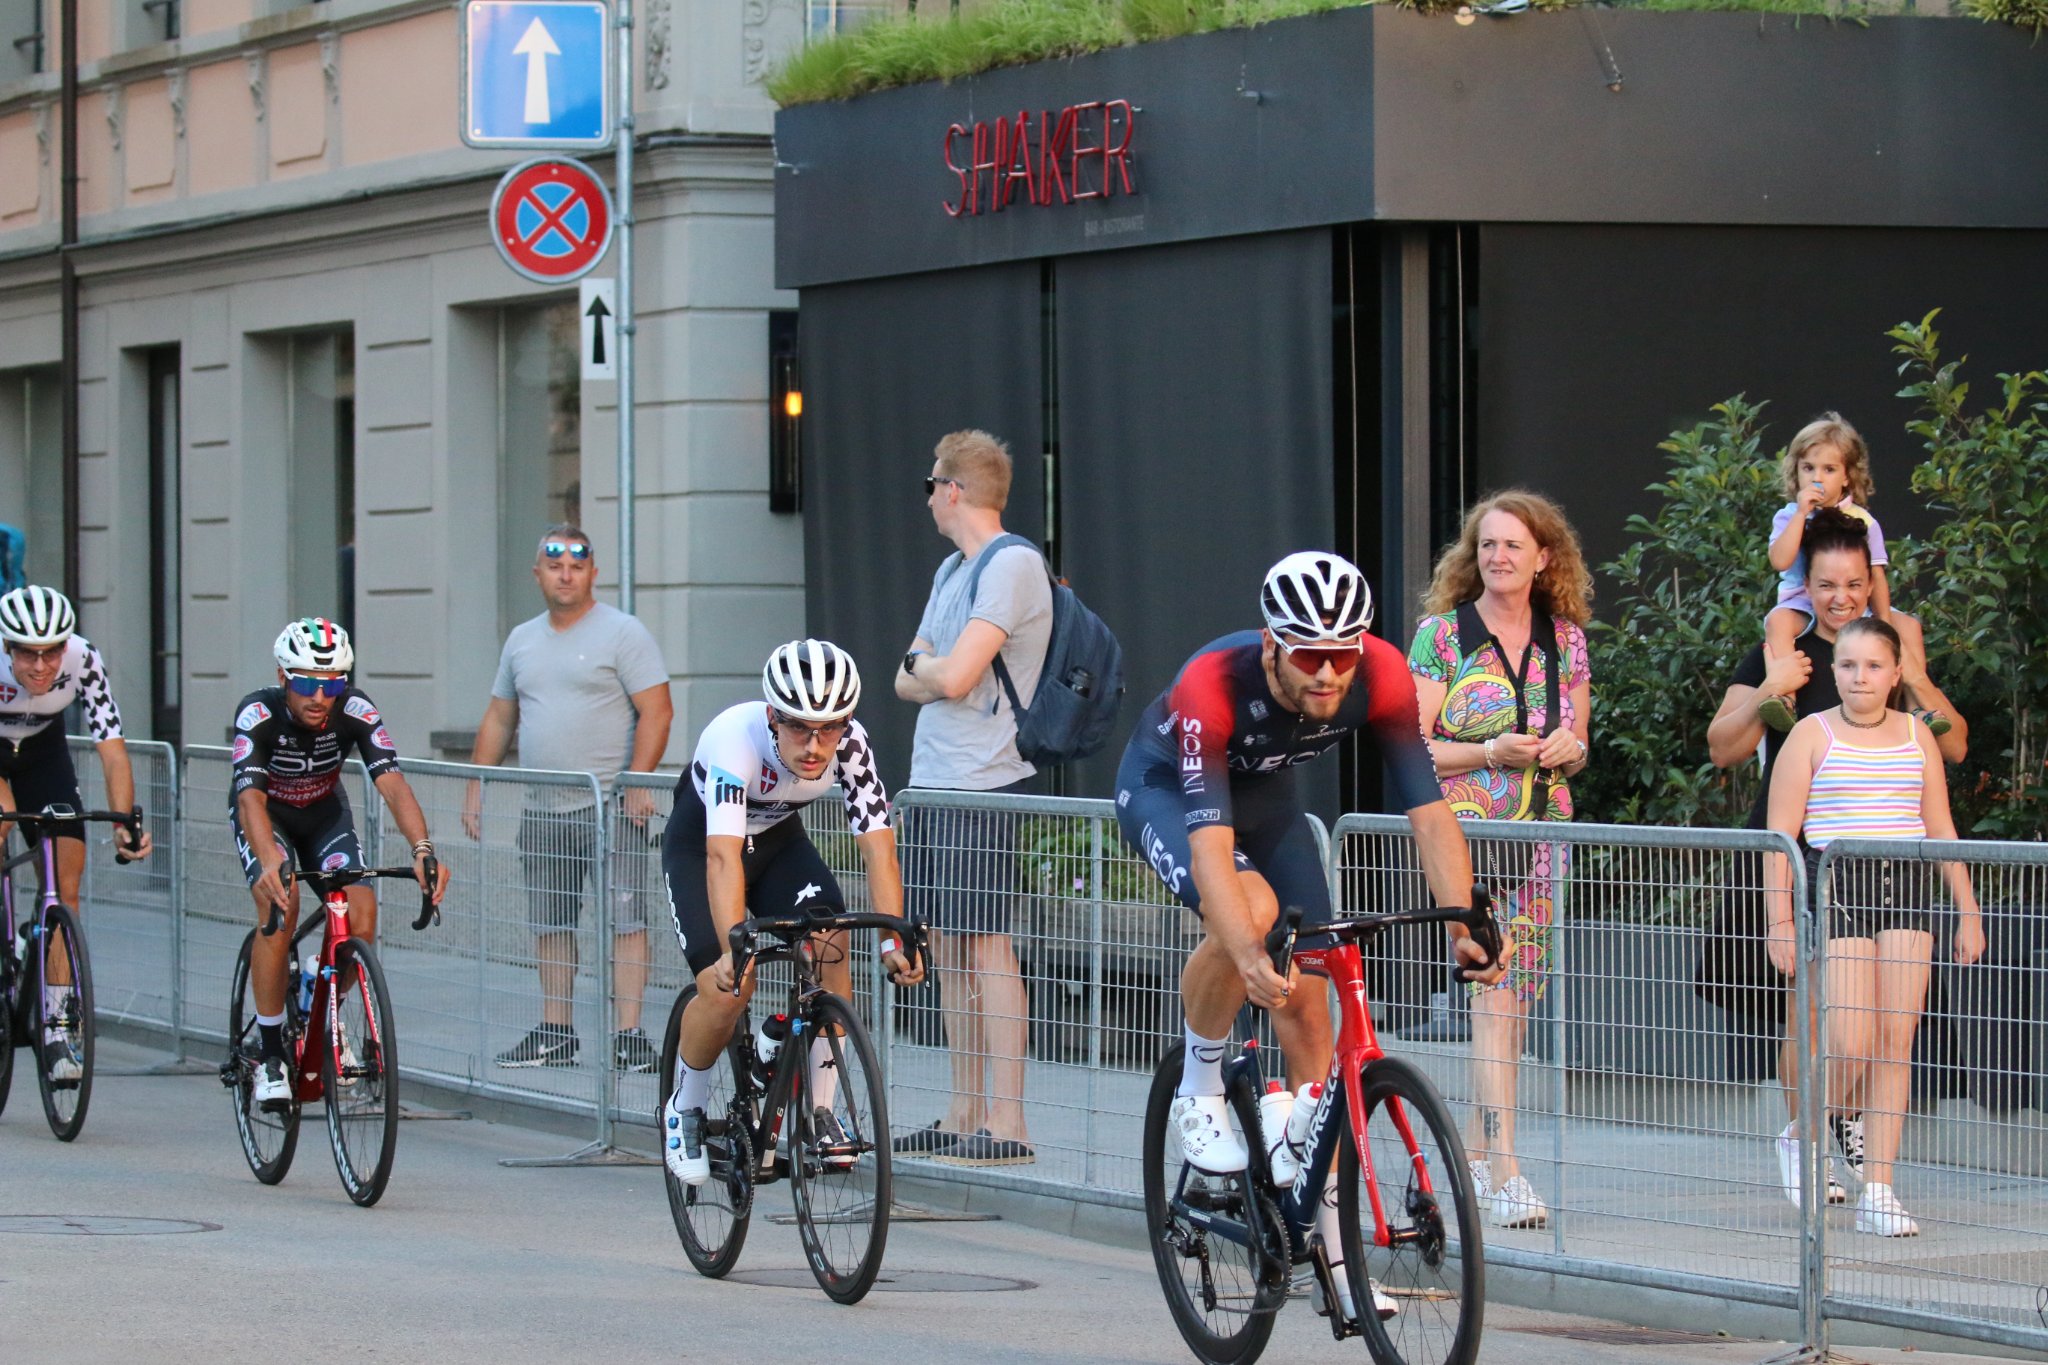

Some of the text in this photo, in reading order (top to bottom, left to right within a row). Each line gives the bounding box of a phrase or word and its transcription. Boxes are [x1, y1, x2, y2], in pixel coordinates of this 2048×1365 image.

[943, 99, 1133, 217] SHAKER
[240, 703, 270, 730] OMZ
[1183, 717, 1205, 795] INEOS
[1141, 822, 1187, 894] INEOS
[330, 983, 339, 1047] BOTTECCHIA
[1293, 1050, 1340, 1206] PINARELLO
[1358, 1134, 1371, 1181] PINARELLO
